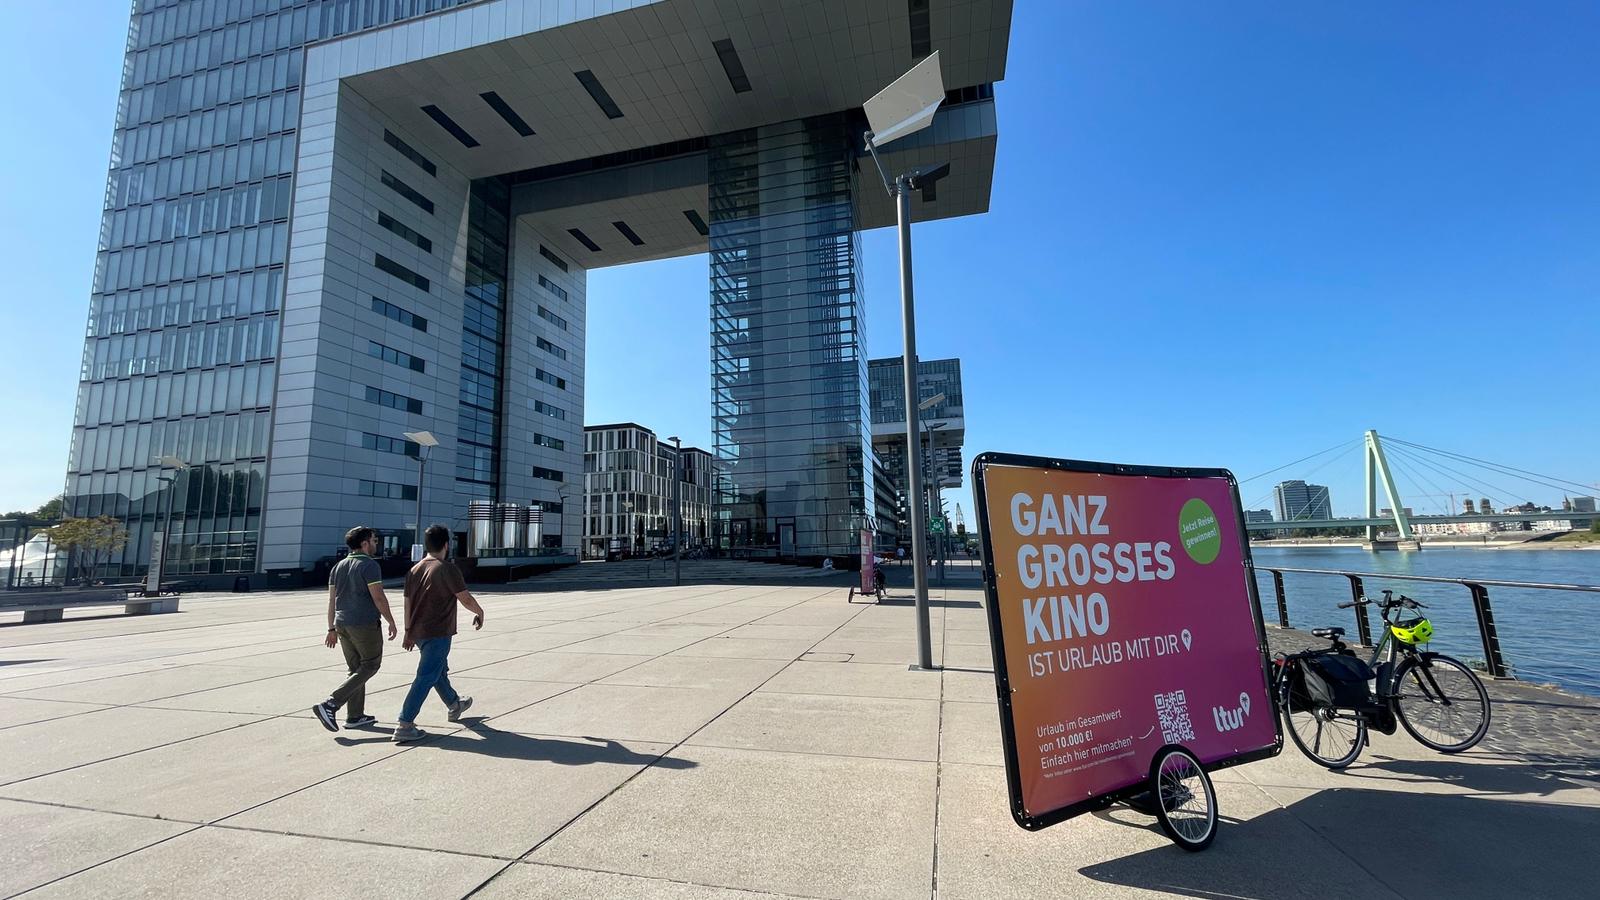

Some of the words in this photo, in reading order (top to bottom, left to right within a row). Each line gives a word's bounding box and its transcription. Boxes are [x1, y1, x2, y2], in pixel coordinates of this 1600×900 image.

[1010, 492, 1110, 536] GANZ
[1183, 521, 1198, 534] Jetzt
[1198, 516, 1214, 528] Reise
[1186, 527, 1217, 549] gewinnen!
[1017, 541, 1176, 589] GROSSES
[1022, 592, 1110, 644] KINO
[1028, 651, 1054, 677] IST
[1058, 641, 1123, 672] URLAUB
[1125, 637, 1151, 661] MIT
[1154, 634, 1180, 656] DIR
[1037, 721, 1065, 738] Urlaub
[1066, 719, 1077, 730] im
[1077, 709, 1122, 728] Gesamtwert
[1039, 742, 1054, 753] von
[1056, 732, 1084, 748] 10.000
[1085, 730, 1094, 742] €!
[1040, 752, 1073, 769] Einfach
[1074, 748, 1090, 761] hier
